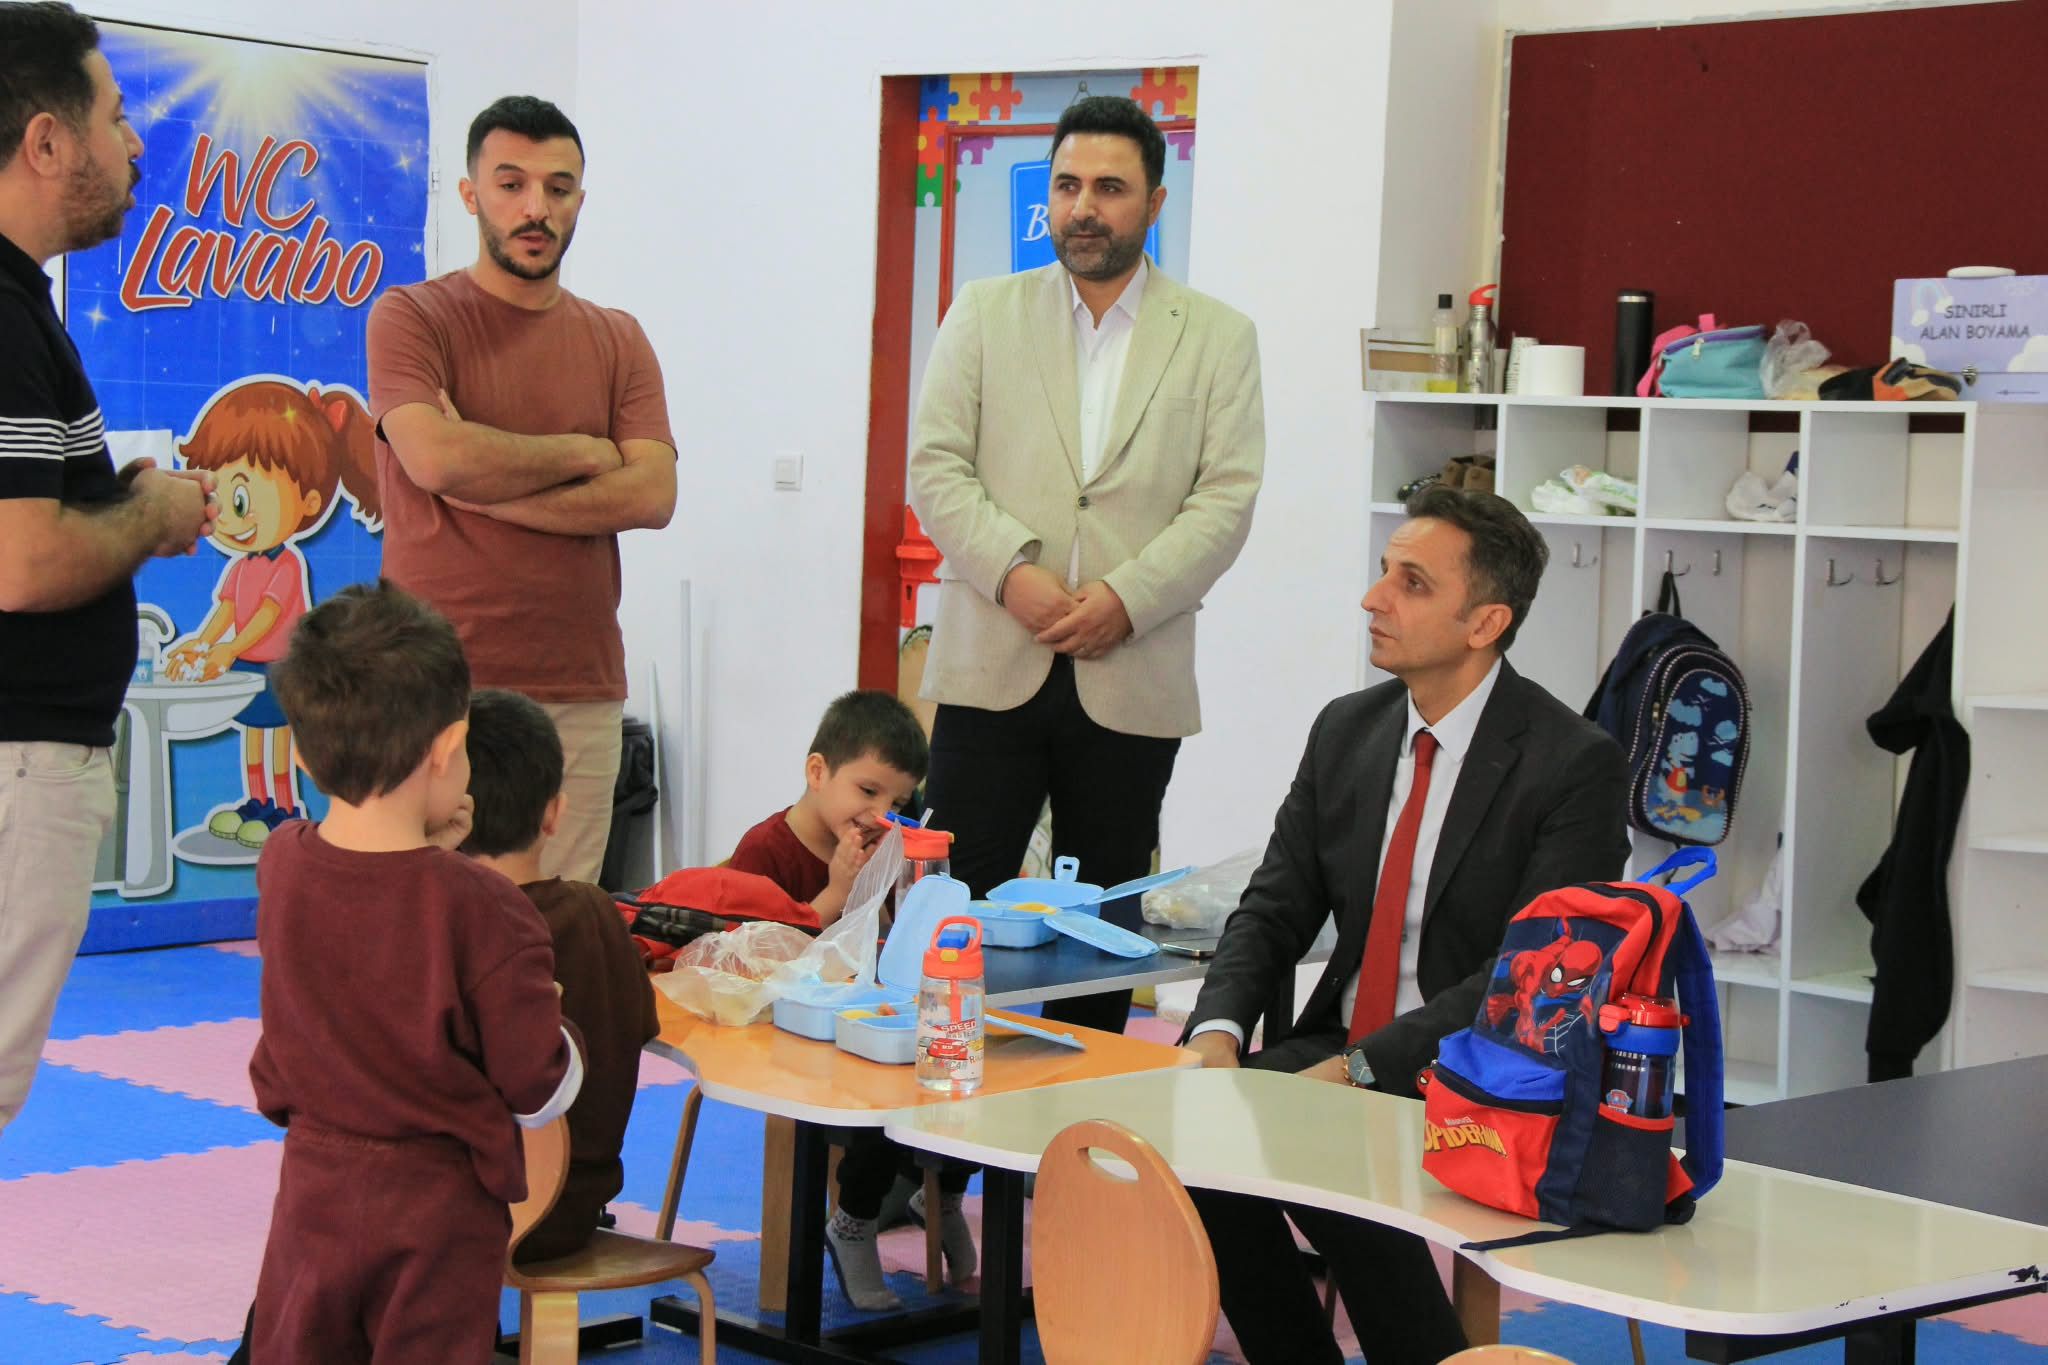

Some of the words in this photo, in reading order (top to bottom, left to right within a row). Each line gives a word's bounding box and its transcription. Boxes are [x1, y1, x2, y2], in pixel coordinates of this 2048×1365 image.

[185, 133, 319, 231] WC
[120, 204, 384, 312] Lavabo
[1944, 304, 2007, 319] SINIRLI
[1920, 326, 1960, 340] ALAN
[1966, 325, 2031, 340] BOYAMA
[941, 1021, 977, 1032] SPEED
